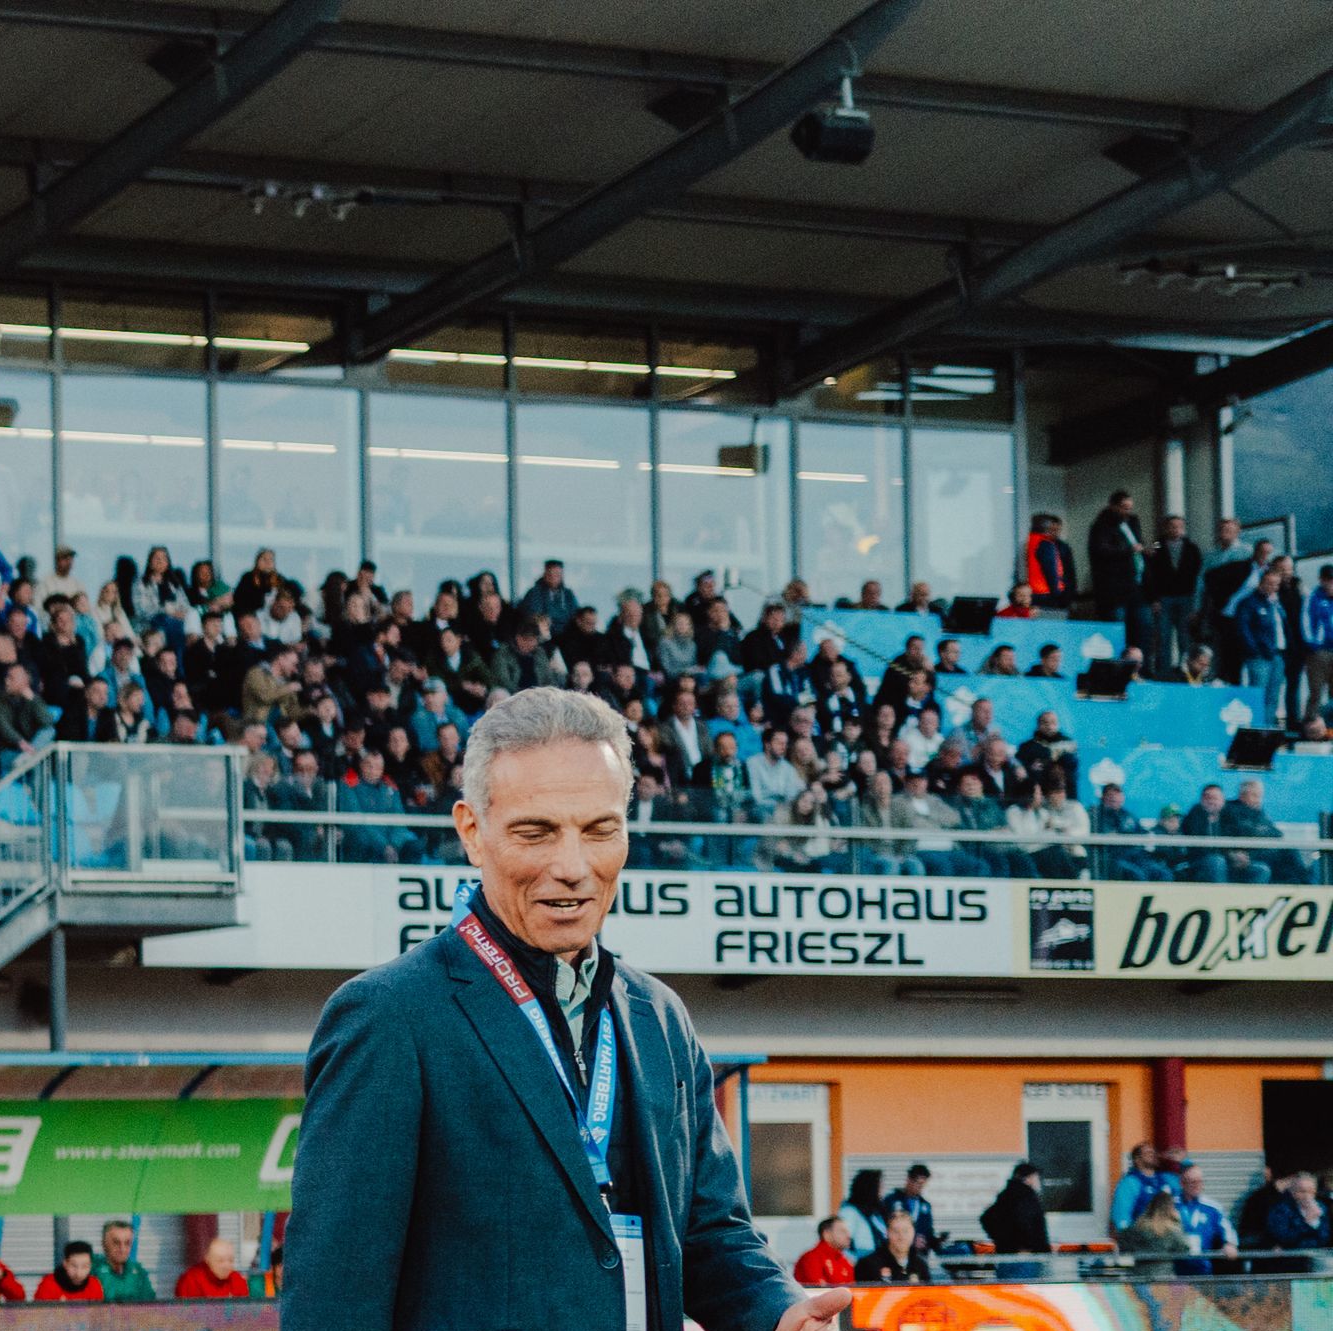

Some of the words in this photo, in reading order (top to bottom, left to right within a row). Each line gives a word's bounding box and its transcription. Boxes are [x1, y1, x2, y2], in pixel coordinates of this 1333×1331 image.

[715, 930, 925, 966] FRIESZL
[601, 1017, 615, 1046] TSV
[593, 1044, 617, 1123] HARTBERG
